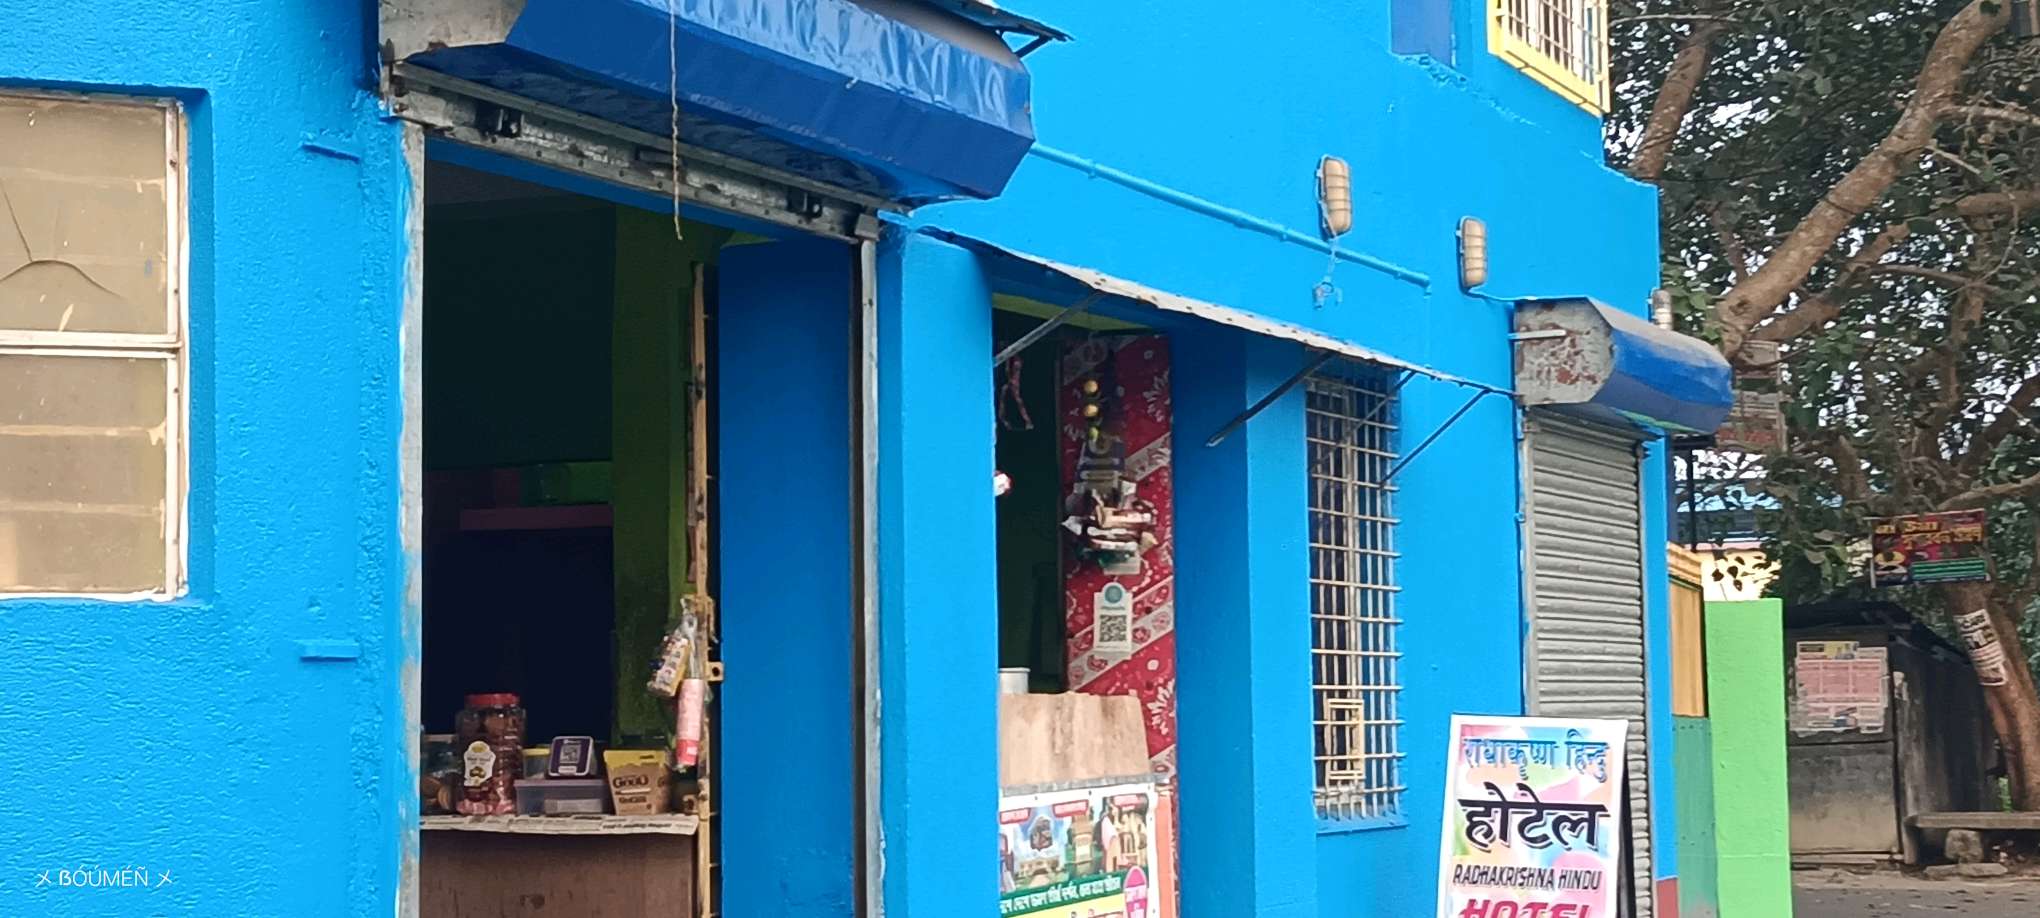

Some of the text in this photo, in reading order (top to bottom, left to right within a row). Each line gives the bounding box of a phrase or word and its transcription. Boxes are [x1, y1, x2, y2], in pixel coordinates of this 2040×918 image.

[1457, 781, 1611, 853] होटेल
[1453, 864, 1602, 891] RADHAKRISHNA HINDU
